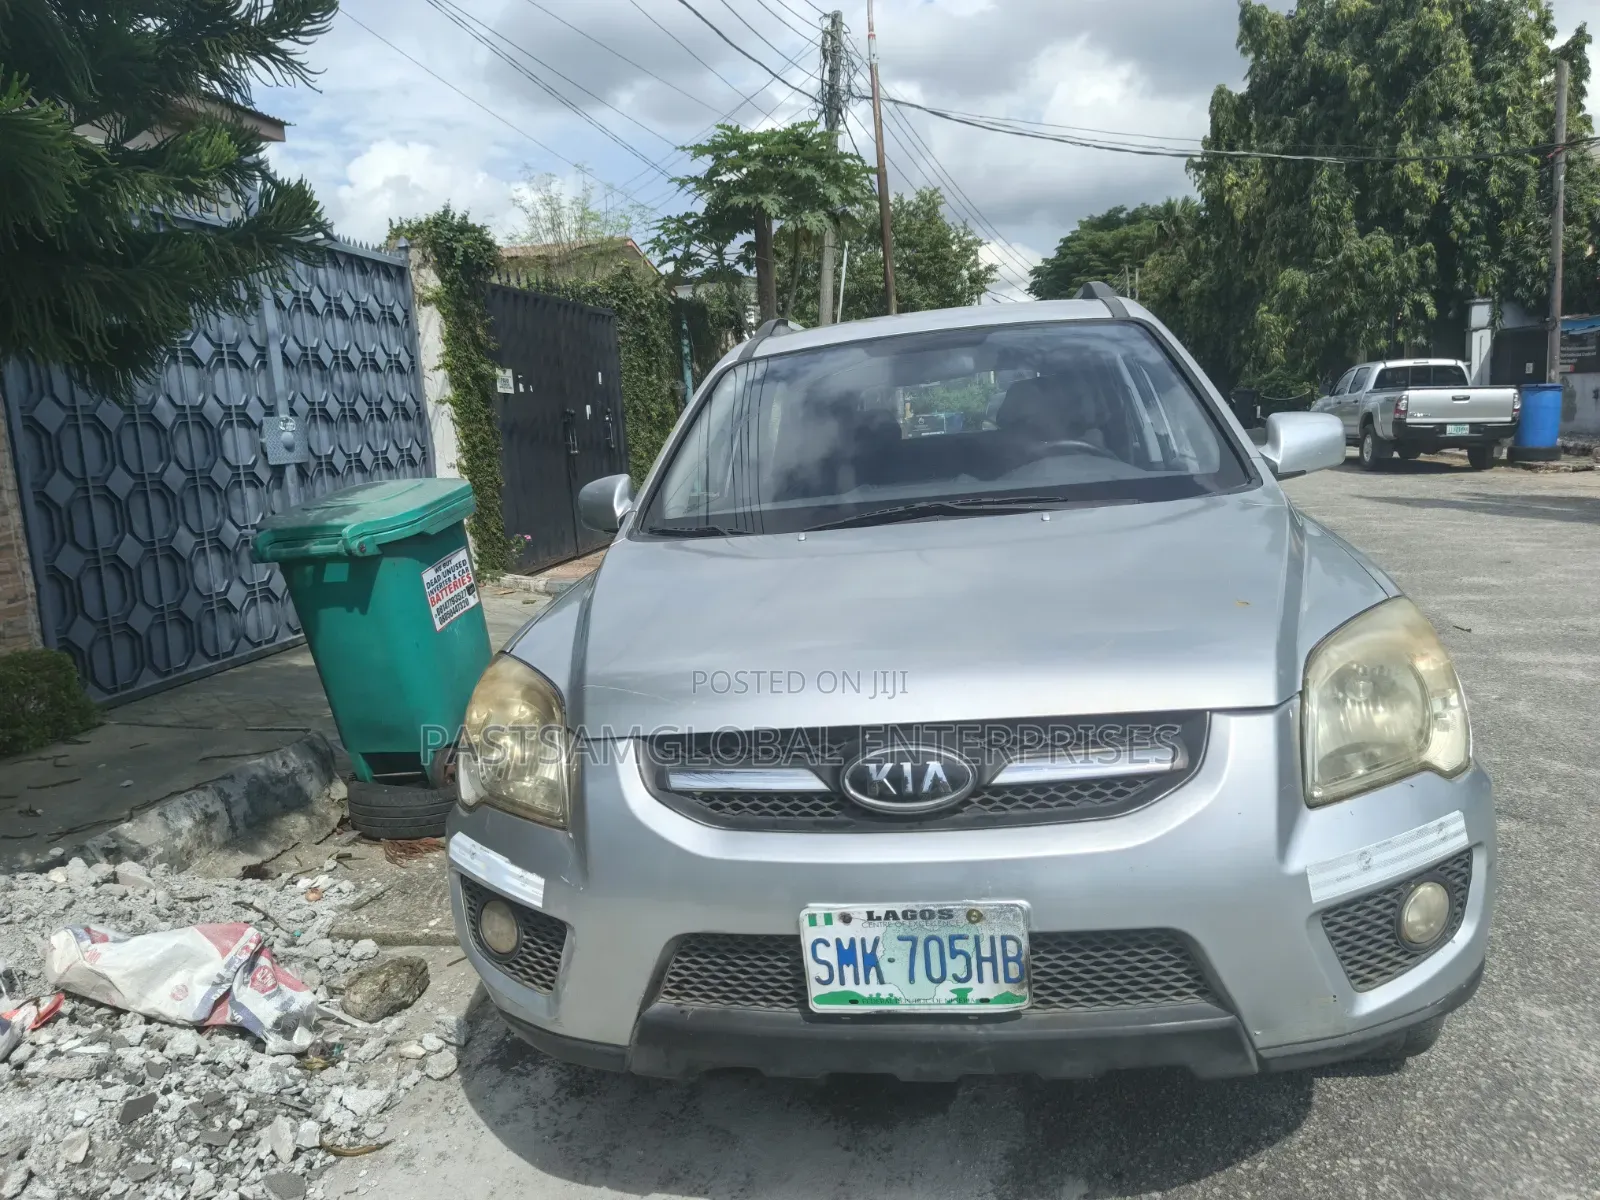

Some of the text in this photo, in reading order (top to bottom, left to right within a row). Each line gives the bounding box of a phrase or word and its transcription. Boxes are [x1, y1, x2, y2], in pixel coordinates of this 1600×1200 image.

[426, 559, 467, 590] DEAD UNUSED
[427, 576, 452, 598] INVERTER
[457, 566, 470, 577] CAR
[434, 559, 452, 574] WE BUY
[429, 572, 472, 608] BATTERIES
[865, 760, 953, 796] KIA
[866, 909, 954, 921] LAGOS
